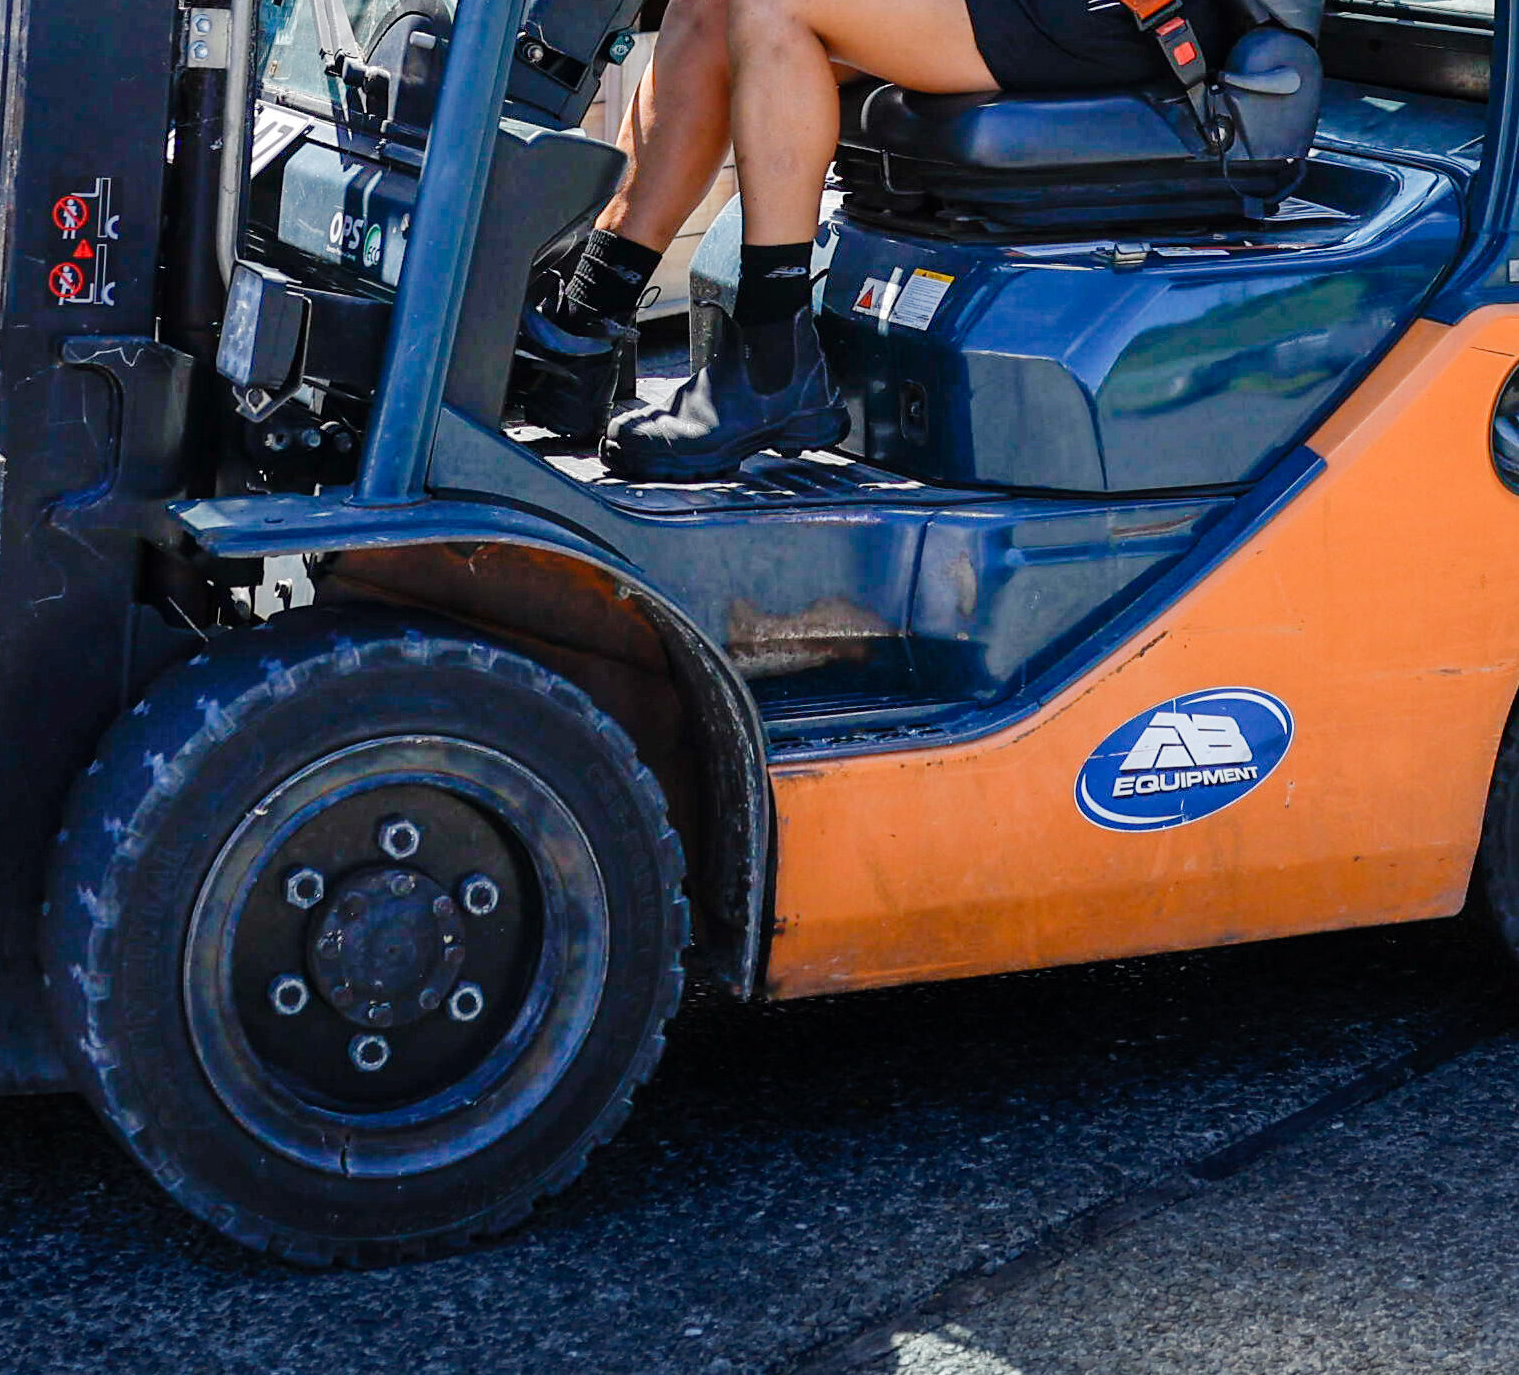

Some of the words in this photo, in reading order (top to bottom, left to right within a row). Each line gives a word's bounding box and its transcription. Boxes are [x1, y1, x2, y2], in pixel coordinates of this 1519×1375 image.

[330, 211, 364, 250] OPS
[1119, 711, 1253, 771] AB
[1112, 766, 1258, 798] EQUIPMENT
